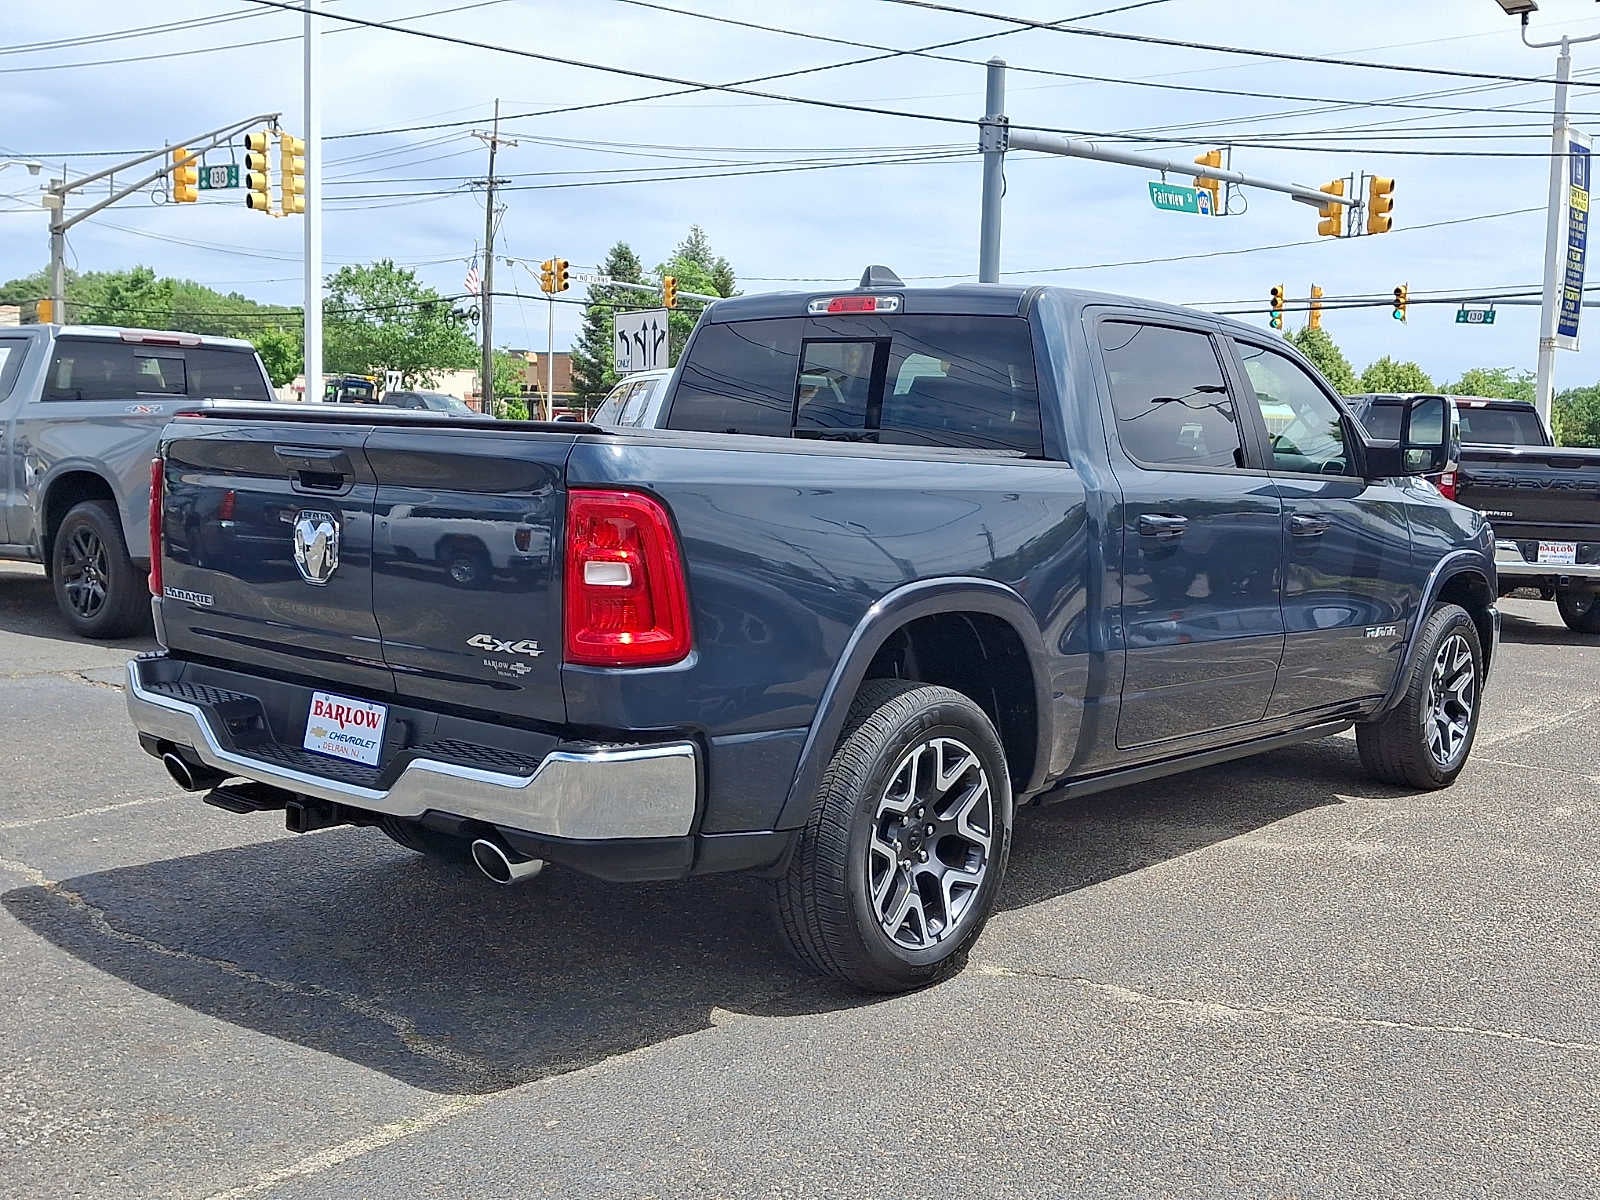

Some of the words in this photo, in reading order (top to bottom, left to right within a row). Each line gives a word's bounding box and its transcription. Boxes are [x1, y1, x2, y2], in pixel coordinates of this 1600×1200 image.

[212, 171, 225, 184] 130
[1153, 188, 1184, 206] Fairview
[579, 274, 588, 282] NO
[1469, 312, 1483, 321] 130
[617, 359, 631, 368] ONLY
[1539, 545, 1575, 554] BARLOW
[164, 587, 212, 605] LARAMIE
[483, 659, 509, 671] BARLOW
[313, 699, 382, 730] BARLOW
[329, 731, 377, 750] CHEVROLET
